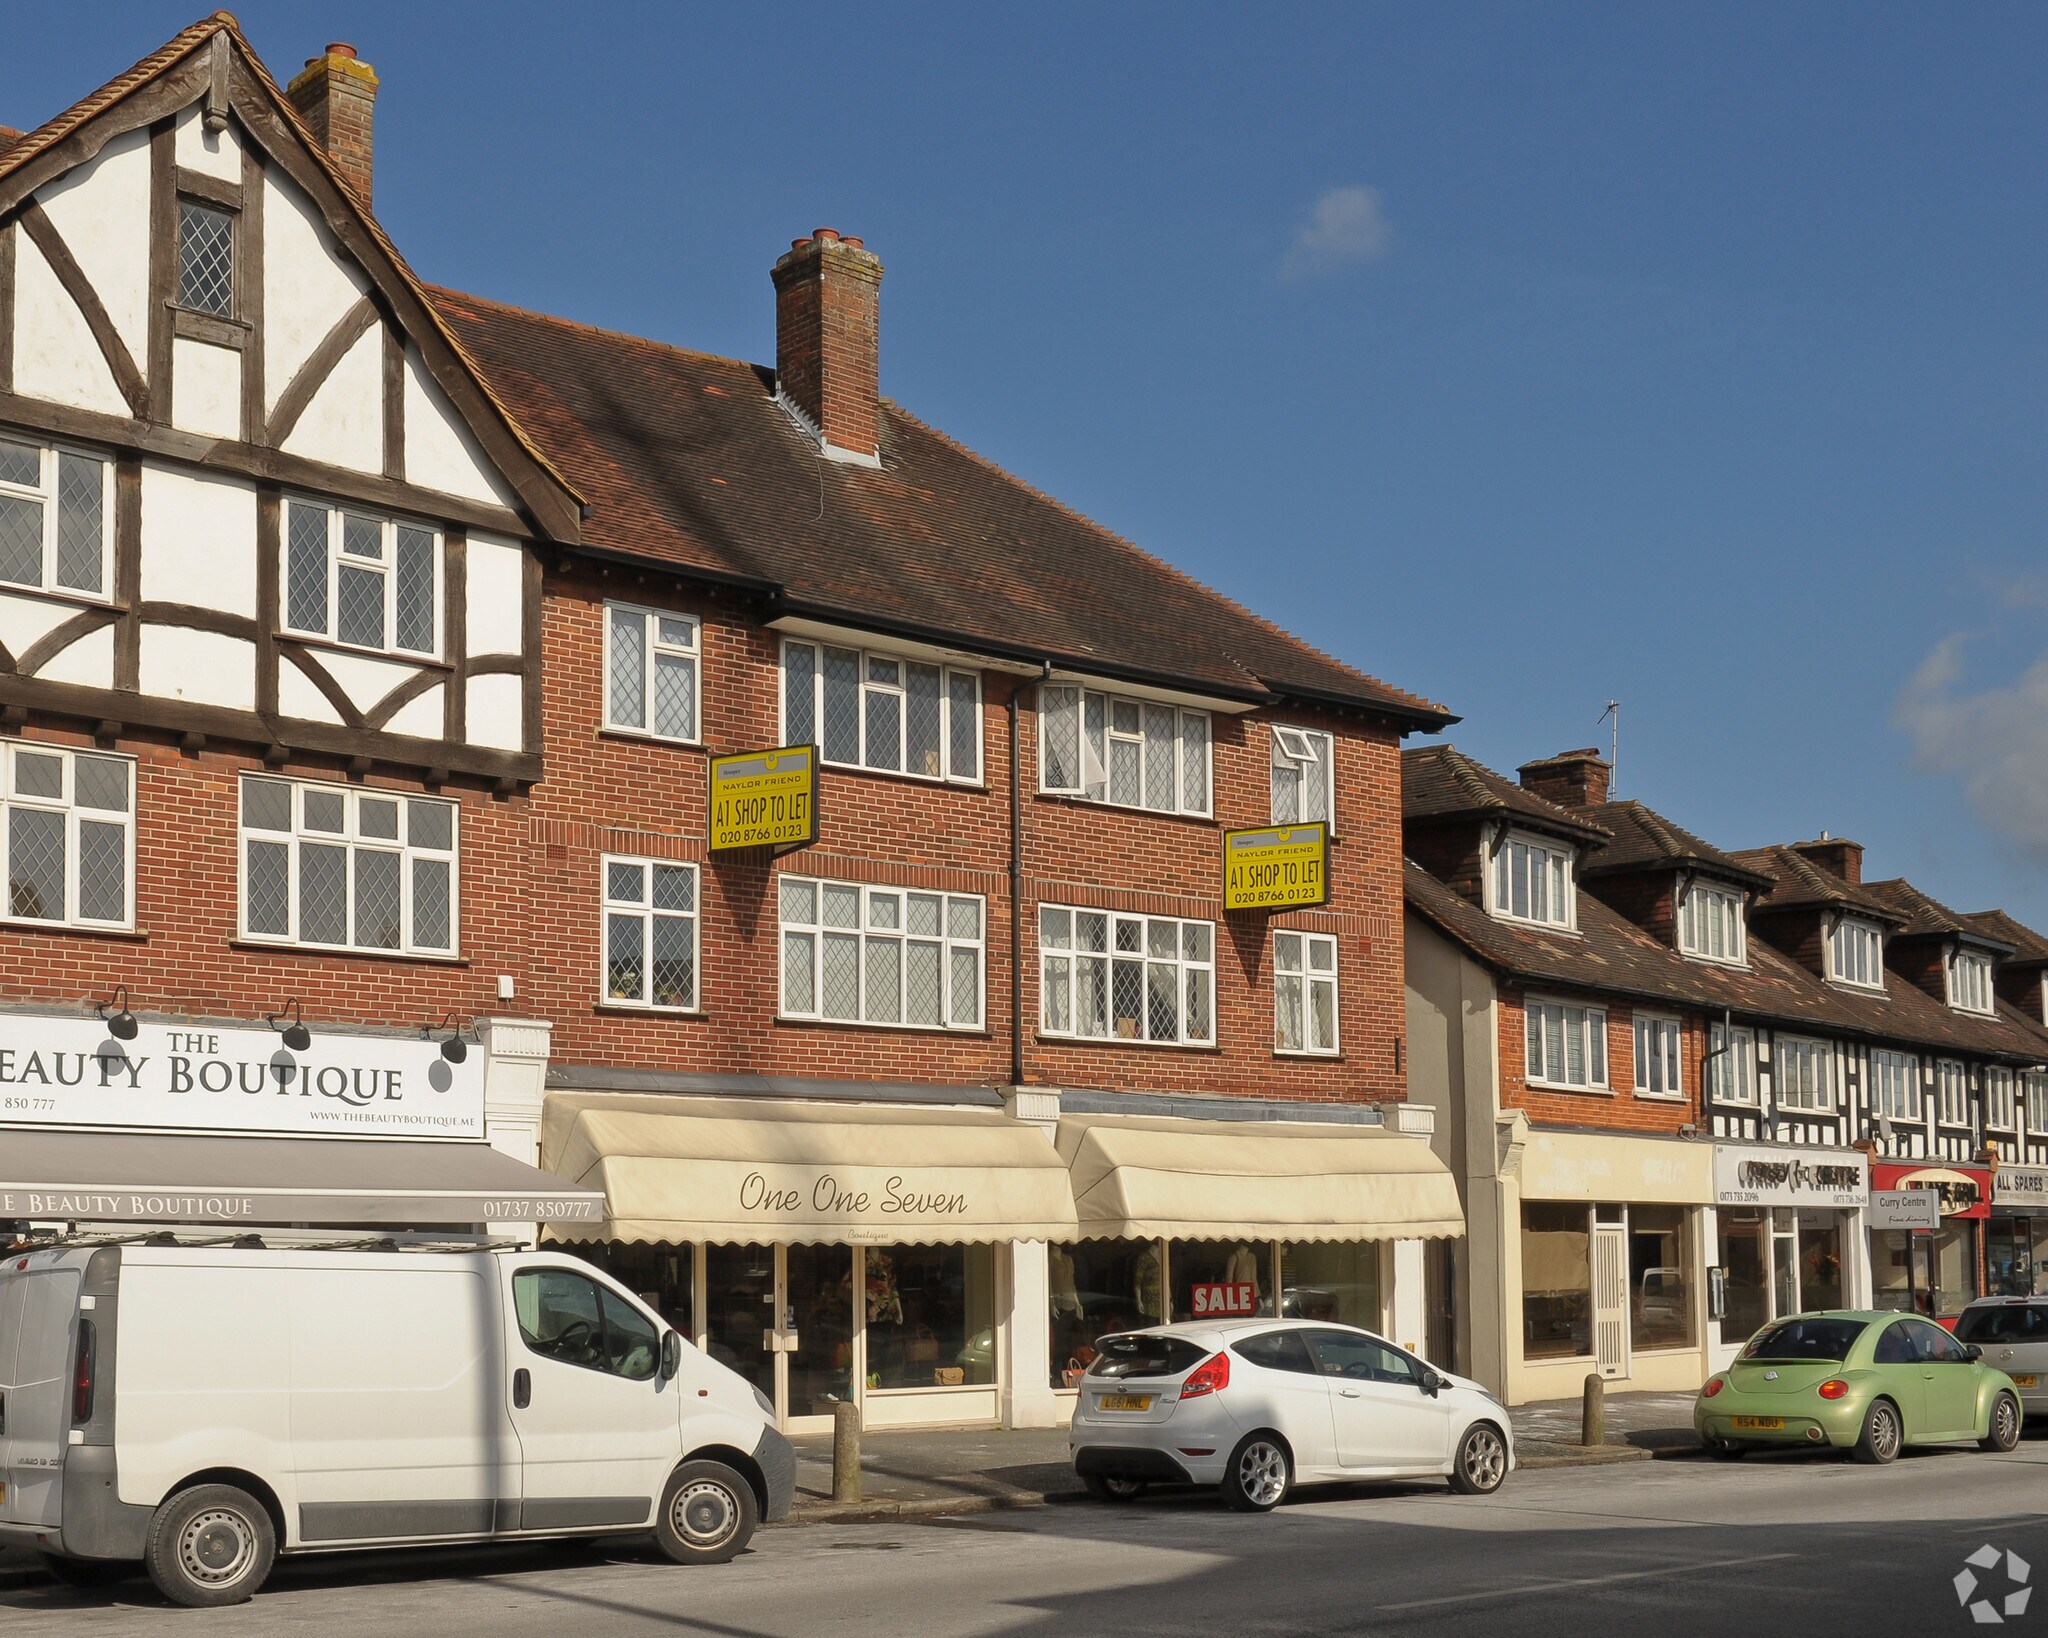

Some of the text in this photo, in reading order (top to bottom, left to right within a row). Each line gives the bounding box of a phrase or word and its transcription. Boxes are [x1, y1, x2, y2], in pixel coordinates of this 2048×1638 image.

[723, 776, 801, 791] NAYLOR FRIEND
[716, 793, 808, 828] A1 SHOP TO LET
[720, 824, 802, 844] 020 8766 0123
[1236, 847, 1314, 858] NAYLOR FRIEND
[1230, 860, 1320, 890] A1 SHOP TO LET
[1234, 887, 1315, 904] 020 8766 0123
[167, 1032, 219, 1054] THE
[168, 1055, 403, 1107] BOUTIQUE
[4, 1097, 56, 1110] 850 777
[310, 1111, 475, 1127] WWW.THEBEAUTYBOUTIQUE.ME
[1997, 1174, 2043, 1192] ALL SPARES
[740, 1171, 968, 1214] One One Seven
[29, 1193, 121, 1213] BEAUTY
[131, 1196, 252, 1219] BOUTIQUE
[483, 1200, 592, 1217] 01737 850777
[1879, 1196, 1927, 1209] Curry Centre
[848, 1228, 890, 1242] Boutique
[1194, 1286, 1251, 1312] SALE
